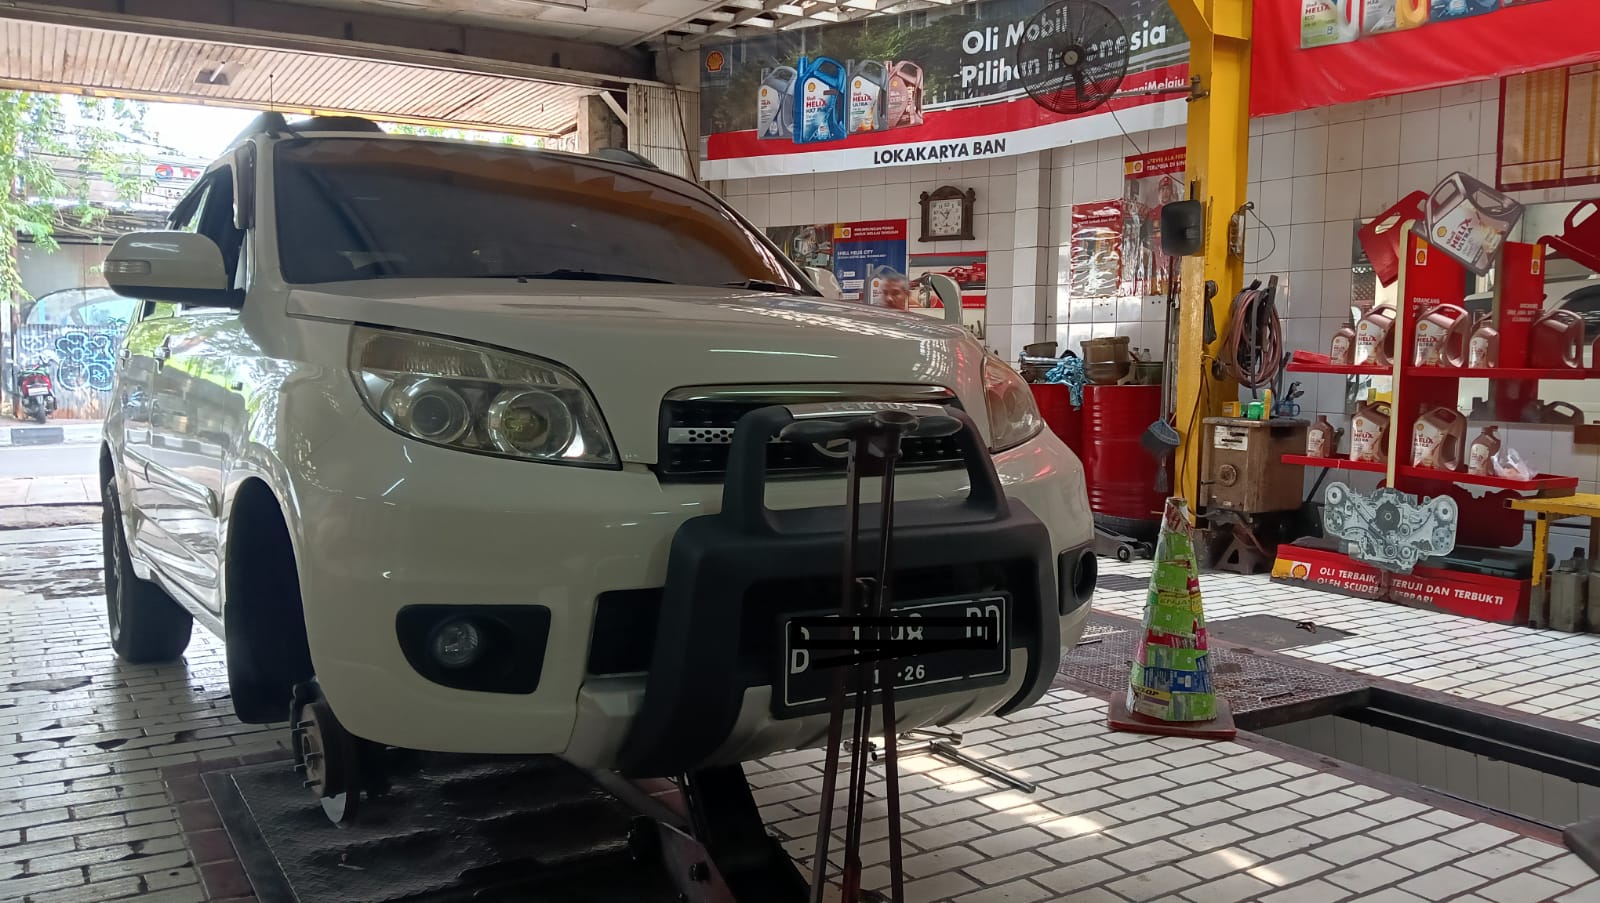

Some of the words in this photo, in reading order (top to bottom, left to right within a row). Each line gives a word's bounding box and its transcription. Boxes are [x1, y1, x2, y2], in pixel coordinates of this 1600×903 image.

[1305, 3, 1331, 15] HELIX
[962, 26, 999, 55] Oli
[1005, 6, 1068, 48] Mobil
[961, 57, 1040, 88] Pilihan
[873, 143, 969, 165] LOKAKARYA
[972, 138, 1006, 156] BAN
[1450, 218, 1472, 250] HELIX
[1319, 567, 1336, 576] OLI
[1338, 569, 1379, 585] TERBAIK,
[1391, 579, 1424, 592] TERUJI
[1425, 584, 1451, 597] DAN
[1453, 589, 1505, 606] TERBUKTI
